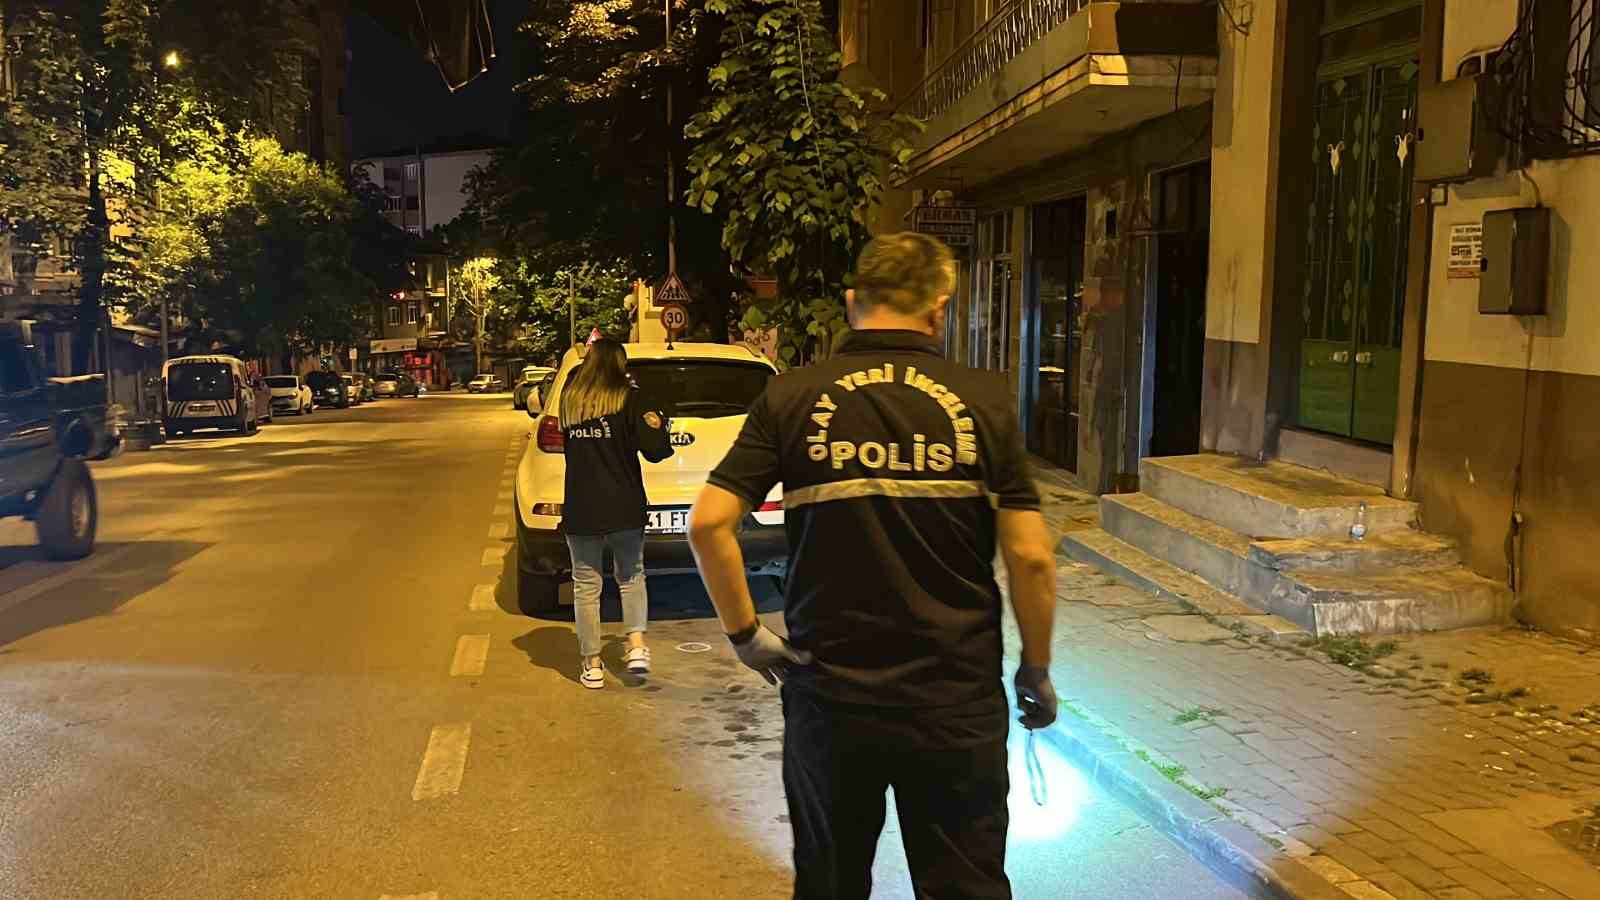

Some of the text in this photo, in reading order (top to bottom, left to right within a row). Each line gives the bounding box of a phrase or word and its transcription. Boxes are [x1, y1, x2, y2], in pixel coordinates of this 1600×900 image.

[666, 312, 683, 323] 30
[670, 433, 691, 444] KIA
[807, 393, 838, 461] OLAY
[830, 433, 954, 472] POLİS
